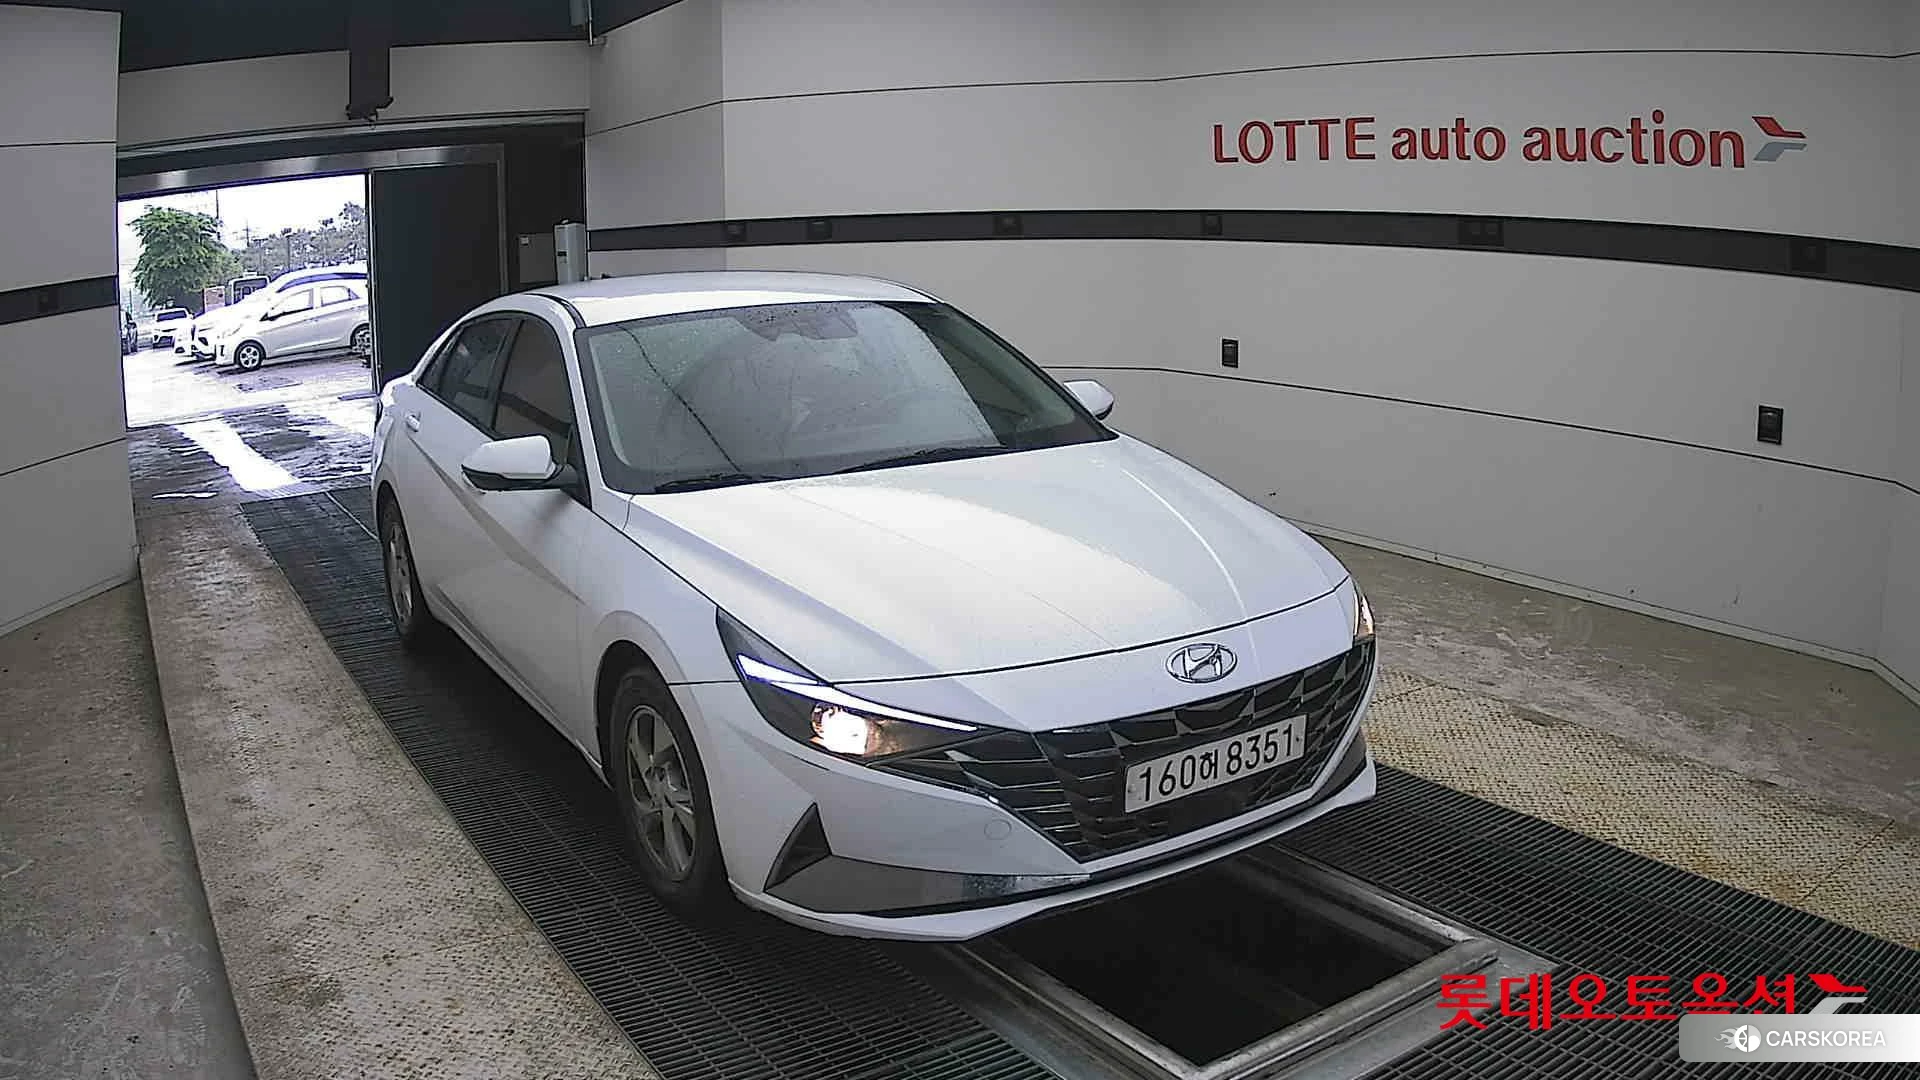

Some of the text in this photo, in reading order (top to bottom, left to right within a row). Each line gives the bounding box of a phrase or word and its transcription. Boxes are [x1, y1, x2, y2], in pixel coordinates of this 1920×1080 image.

[1213, 109, 1746, 169] LOTTE auto auction
[1226, 723, 1293, 776] 8351
